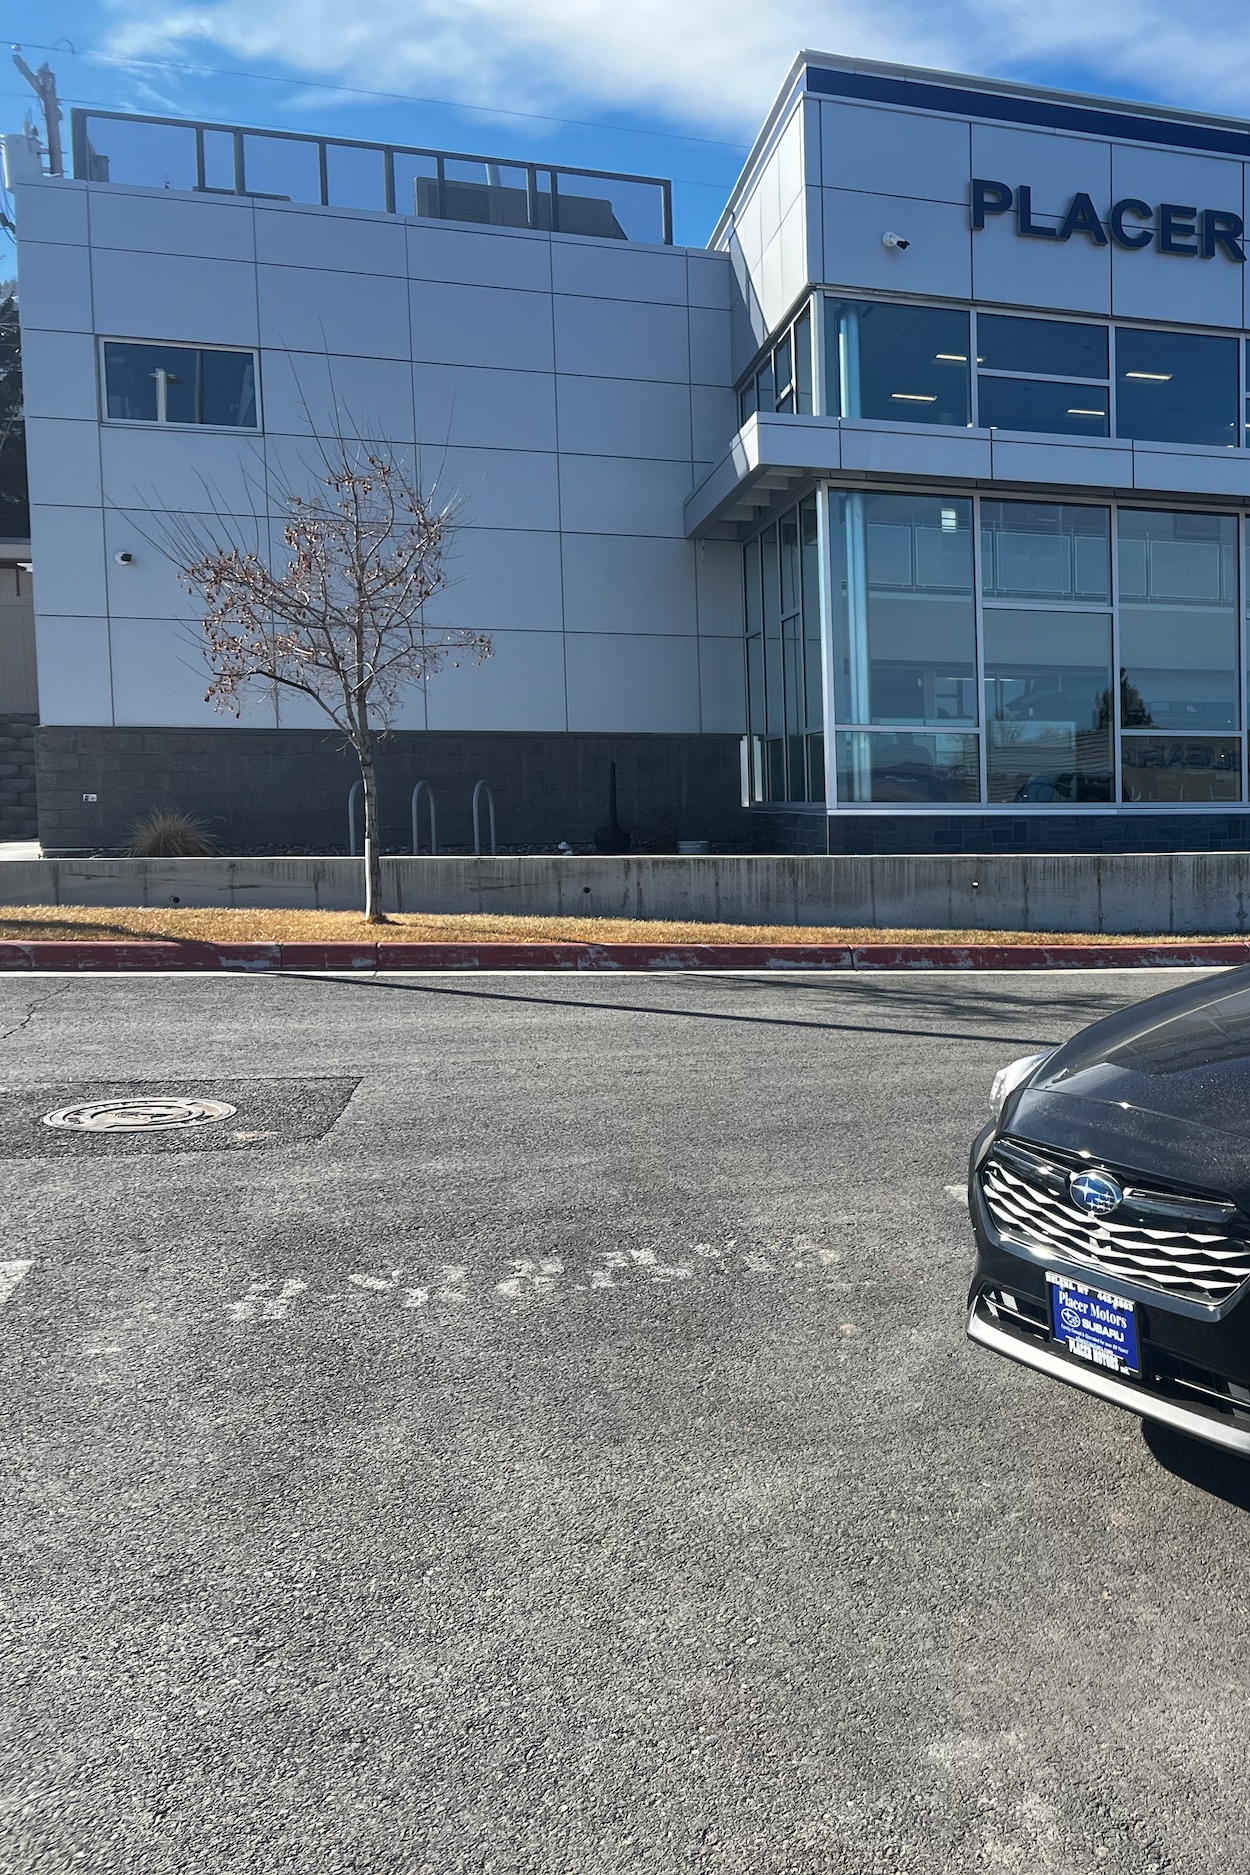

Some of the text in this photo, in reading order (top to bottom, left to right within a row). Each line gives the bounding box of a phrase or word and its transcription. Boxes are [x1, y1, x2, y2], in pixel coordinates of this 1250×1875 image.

[971, 178, 1247, 262] PLACER
[1059, 1290, 1127, 1329] Placer Motors
[1082, 1318, 1124, 1342] SUBARU
[1068, 1338, 1093, 1361] PLACER
[1093, 1347, 1120, 1372] MOTORS
